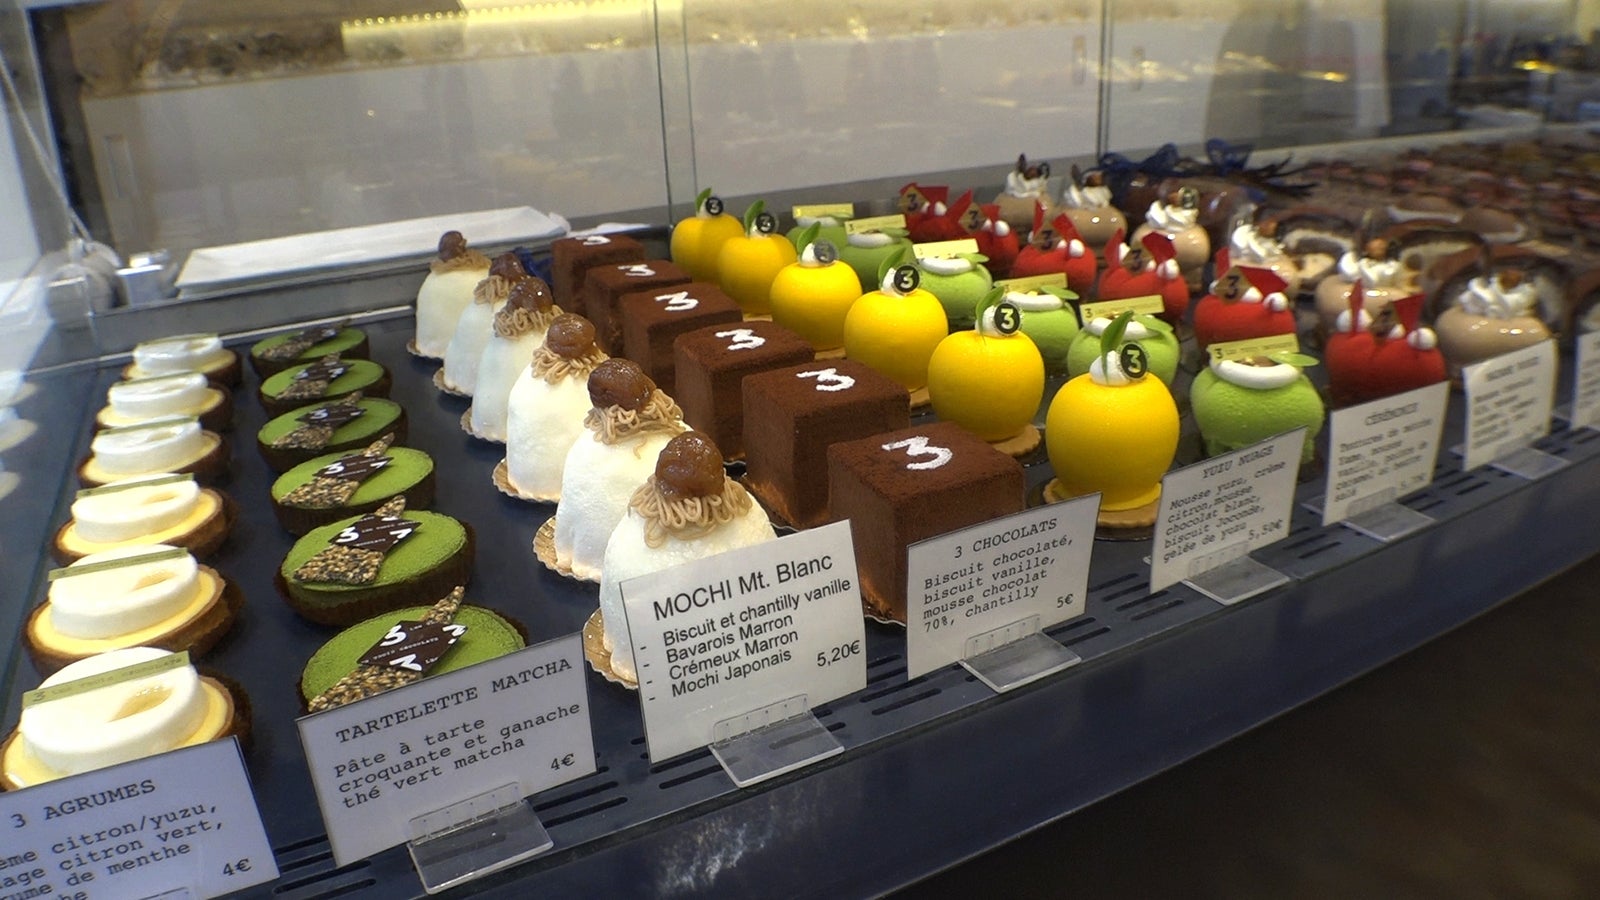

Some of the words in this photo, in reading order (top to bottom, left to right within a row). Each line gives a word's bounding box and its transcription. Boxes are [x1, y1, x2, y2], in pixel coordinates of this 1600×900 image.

[711, 200, 720, 214] 3
[908, 192, 918, 211] 3
[762, 217, 771, 231] 3
[969, 210, 979, 230] 3
[617, 263, 656, 277] 3
[900, 269, 914, 289] 3
[654, 291, 699, 311] 3
[1226, 276, 1239, 298] 3
[1000, 308, 1015, 330] 3
[1085, 308, 1093, 319] 3
[715, 328, 766, 350] 3
[1214, 348, 1224, 360] 3
[1126, 349, 1142, 373] 3
[796, 367, 855, 392] 3
[882, 436, 953, 470] 3
[1202, 460, 1233, 479] YUZU
[1238, 446, 1274, 466] NUAGE
[1169, 488, 1212, 511] Mousse
[1217, 476, 1248, 497] yuzu,
[1164, 525, 1209, 549] biscuit
[1216, 504, 1265, 528] Joconde,
[1166, 508, 1218, 536] chocolat
[1224, 495, 1261, 514] blanc,
[335, 526, 359, 543] 3
[954, 546, 963, 558] 3
[972, 518, 1058, 553] CHOCOLATS
[1202, 534, 1215, 546] de
[1221, 523, 1247, 541] yuzu
[924, 562, 984, 590] Biscuit
[992, 536, 1073, 567] chocolaté,
[653, 580, 732, 621] MOCHI
[738, 571, 771, 595] Mt.
[776, 554, 833, 585] Blanc
[923, 595, 974, 619] mousse
[982, 569, 1047, 598] chocolat
[924, 576, 983, 605] biscuit
[991, 555, 1055, 581] vanille,
[663, 618, 716, 647] Biscuit
[720, 613, 736, 627] et
[739, 592, 800, 624] chantilly
[804, 578, 851, 604] vanille
[924, 615, 954, 633] 70%,
[965, 585, 1039, 618] chantilly
[1056, 593, 1074, 609] 5€
[380, 624, 407, 647] 3
[666, 634, 735, 664] Bavarois
[739, 613, 793, 640] Marron
[669, 649, 740, 680] Crémeux
[745, 629, 799, 656] Marron
[816, 640, 861, 668] 5,20€
[671, 671, 719, 697] Mochi
[724, 648, 792, 681] Japonais
[336, 686, 479, 743] TARTELETTE
[491, 657, 573, 693] MATCHA
[333, 751, 386, 779] Pâte
[399, 741, 412, 756] à
[423, 717, 486, 747] tarte
[338, 745, 451, 794] croquante
[464, 733, 488, 750] et
[499, 703, 581, 740] ganache
[549, 752, 576, 772] 4€
[343, 786, 381, 809] thé
[393, 765, 442, 790] vert
[453, 736, 526, 770] matcha
[11, 812, 27, 829] 3
[44, 778, 157, 820] AGRUMES
[51, 802, 217, 855] citron/yuzu,
[59, 838, 144, 872] citron
[156, 817, 223, 843] vert,
[66, 872, 95, 886] de
[108, 842, 191, 876] menthe
[222, 857, 252, 877] 4€
